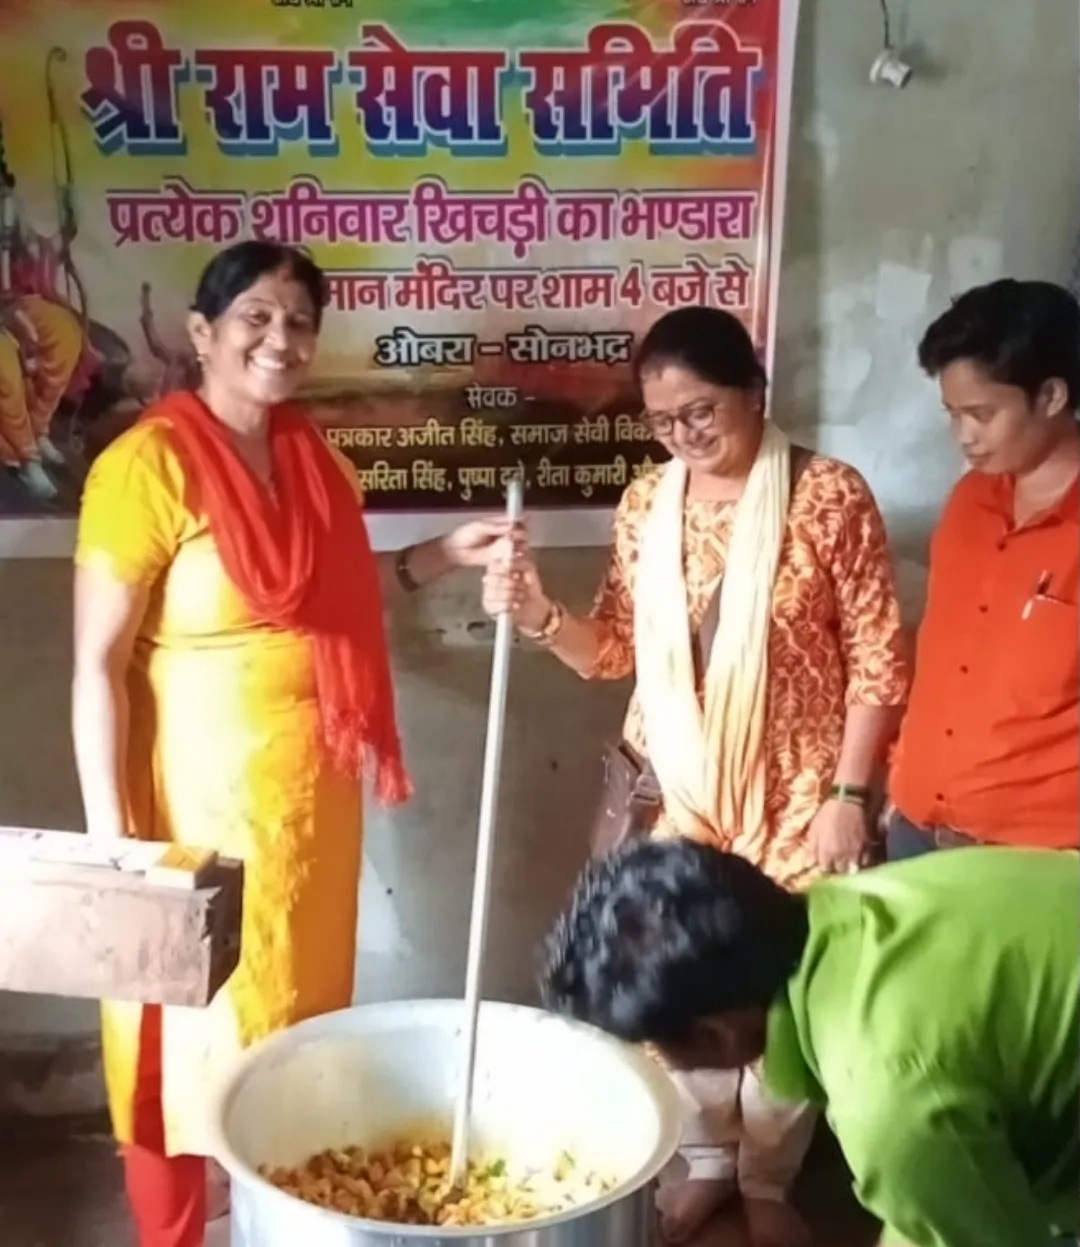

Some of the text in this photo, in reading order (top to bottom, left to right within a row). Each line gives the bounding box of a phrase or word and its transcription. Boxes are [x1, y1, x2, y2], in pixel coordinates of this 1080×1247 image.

[81, 18, 764, 156] श्री राम सेवा समिति
[106, 180, 754, 259] प्रत्येक शनिवार खिचड़ी का भण्डारा
[394, 261, 483, 311] मंदिर
[488, 271, 538, 310] पर
[541, 271, 614, 309] शाम
[620, 265, 642, 307] 4
[651, 262, 710, 307] बजे
[714, 262, 750, 307] से
[376, 326, 475, 365] ओबरा
[508, 326, 632, 365] सोनभद्र
[465, 386, 518, 410] सेवक
[326, 427, 393, 448] पत्रकार
[397, 419, 455, 448] अजीत
[460, 417, 504, 448] सिंह,
[511, 423, 568, 446] समाज
[574, 414, 610, 444] सेवी
[357, 460, 408, 491] सरिता
[412, 457, 453, 491] सिंह,
[458, 466, 495, 500] पुष्पा
[536, 455, 570, 487] रीता
[575, 454, 628, 496] कुमारी
